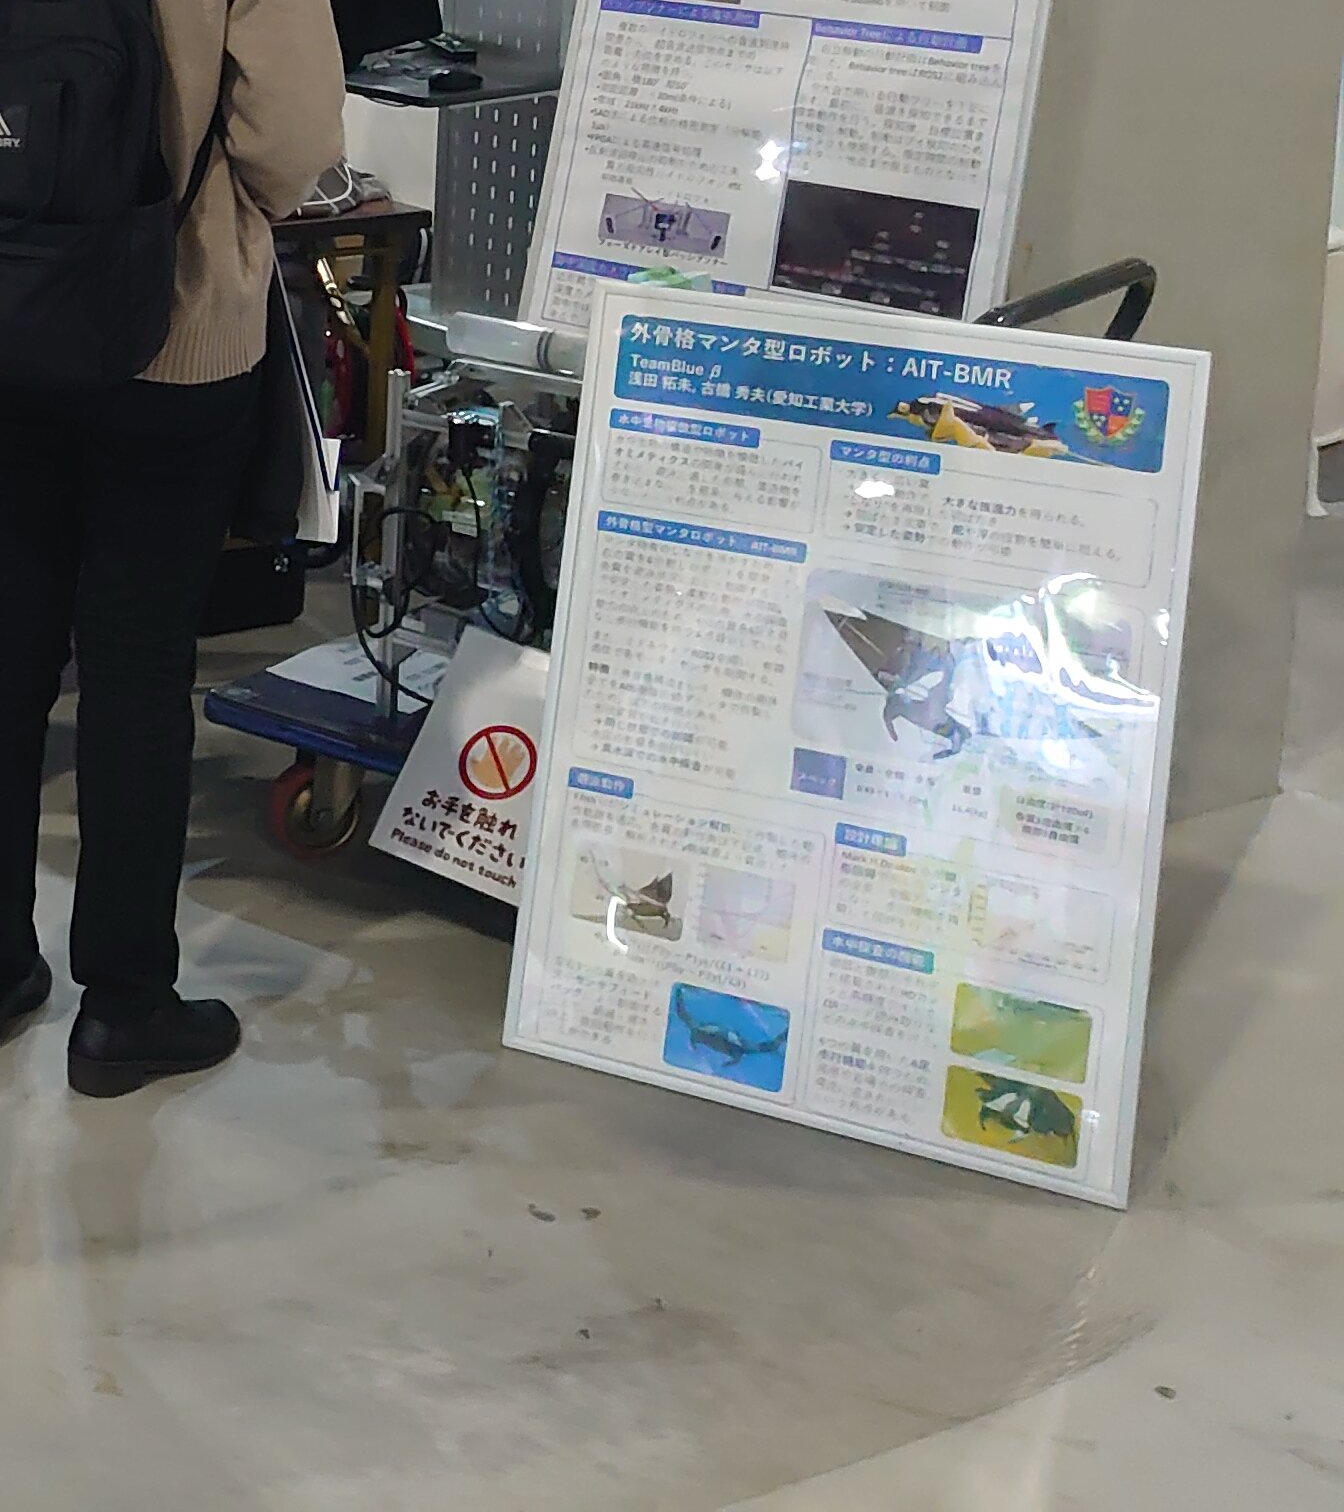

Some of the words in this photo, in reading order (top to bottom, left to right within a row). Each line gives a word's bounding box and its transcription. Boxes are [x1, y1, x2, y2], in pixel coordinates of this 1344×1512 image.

[630, 354, 704, 377] TeamBlue
[403, 806, 526, 869] ないでください
[422, 789, 518, 840] お手を触れ
[391, 828, 433, 853] Please
[434, 847, 450, 861] do
[453, 855, 475, 872] not
[479, 865, 518, 889] touch
